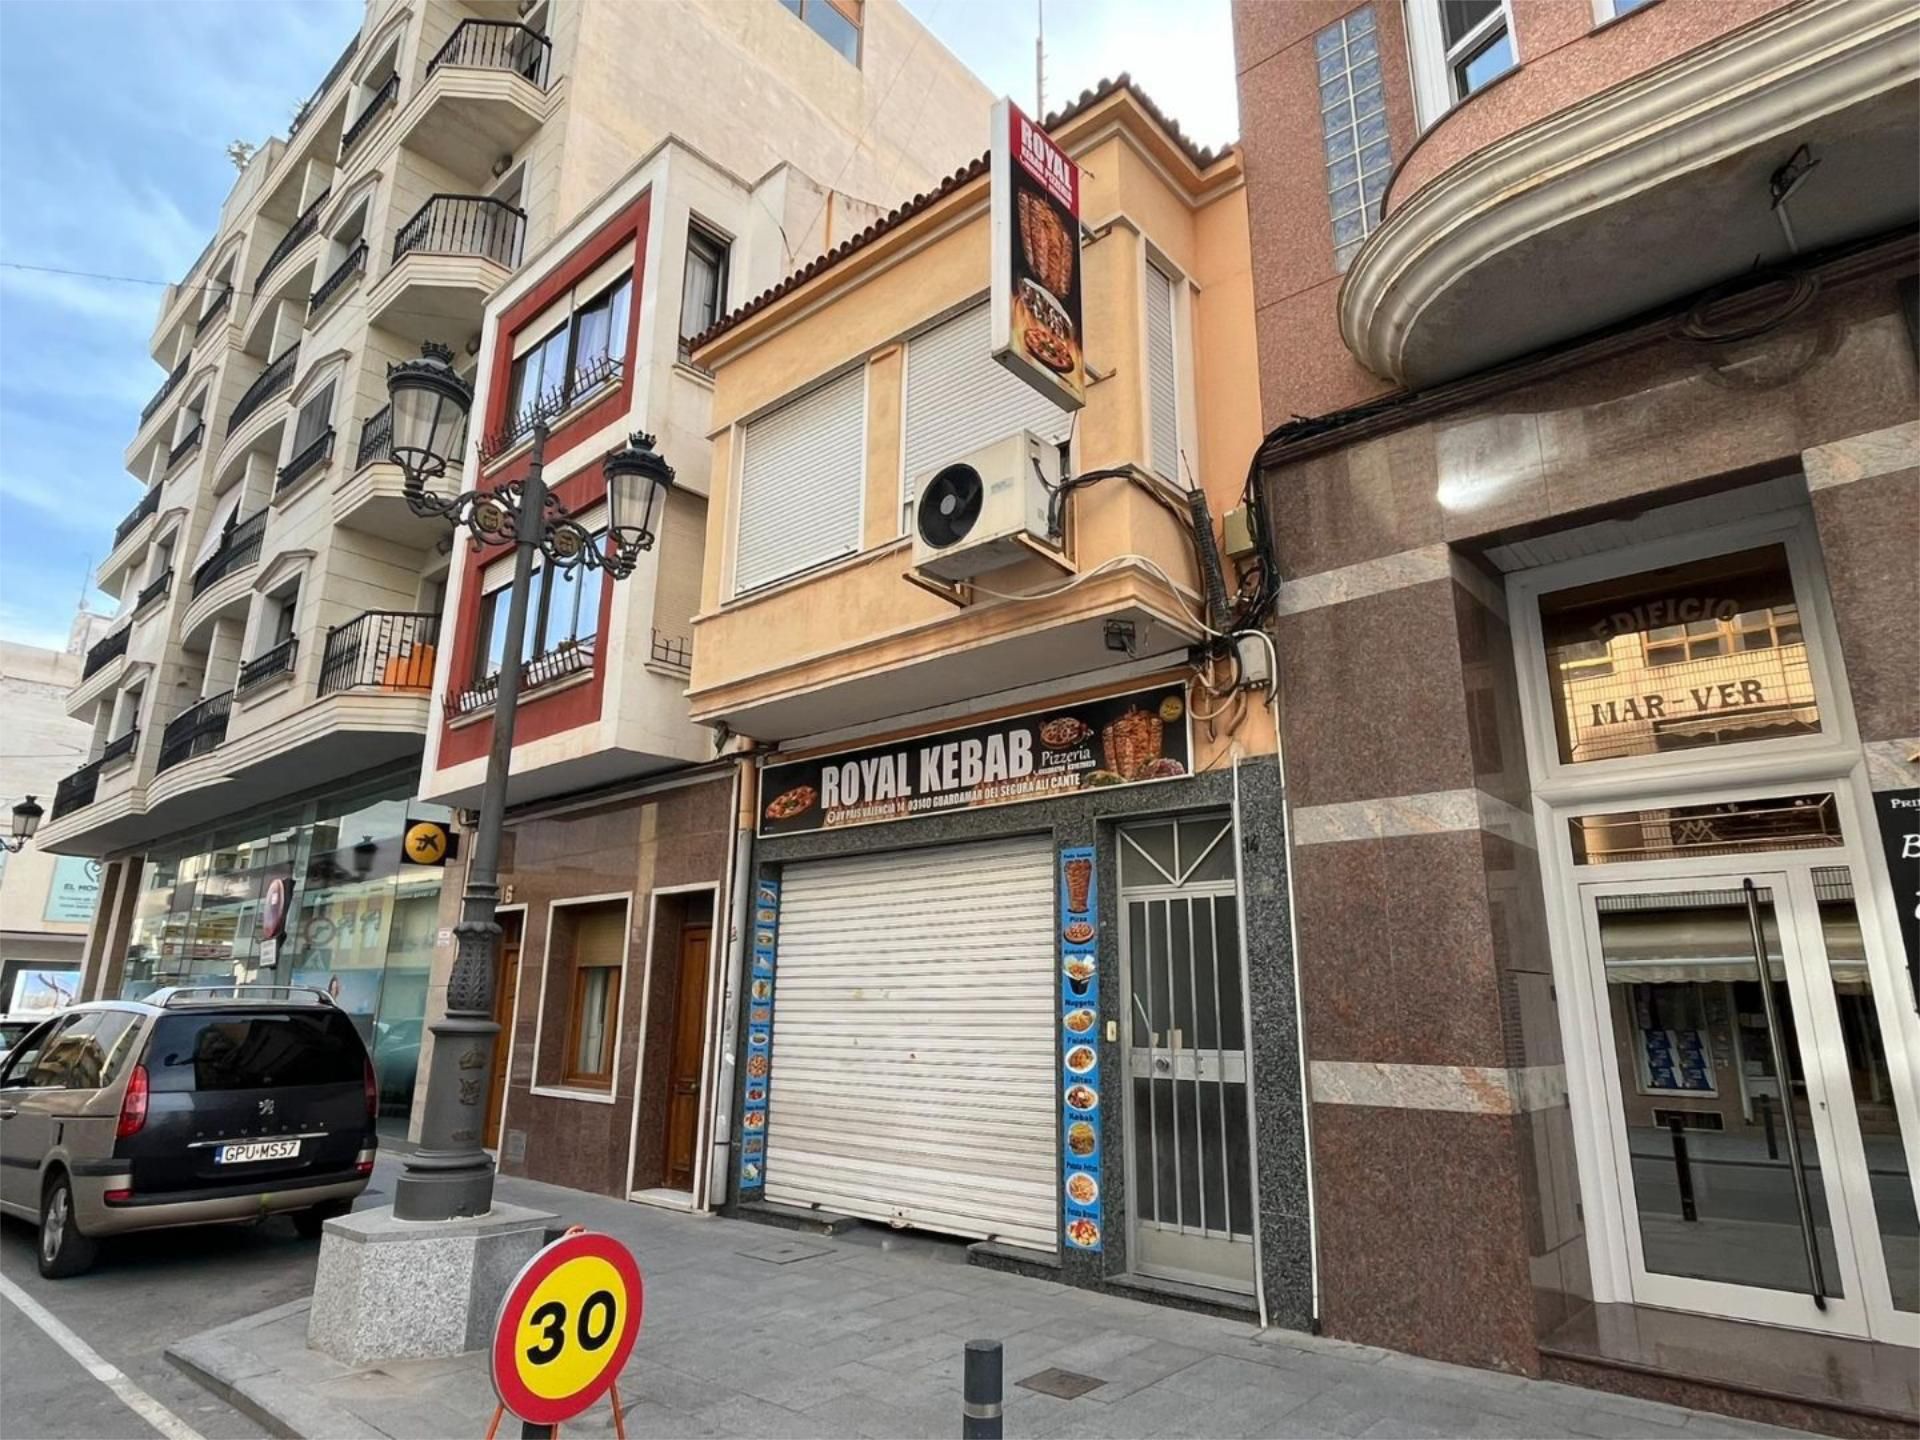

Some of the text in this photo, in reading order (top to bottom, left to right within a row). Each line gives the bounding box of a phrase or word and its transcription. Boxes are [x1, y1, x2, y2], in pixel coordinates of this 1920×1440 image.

[1021, 118, 1072, 192] ROYAL
[1588, 597, 1739, 644] EDIFICIO
[821, 729, 1034, 809] ROYAL KEBAB
[1042, 745, 1091, 766] Pizzeria
[985, 786, 998, 799] DEL
[1000, 780, 1034, 797] SEGURA
[526, 1290, 616, 1366] 30
